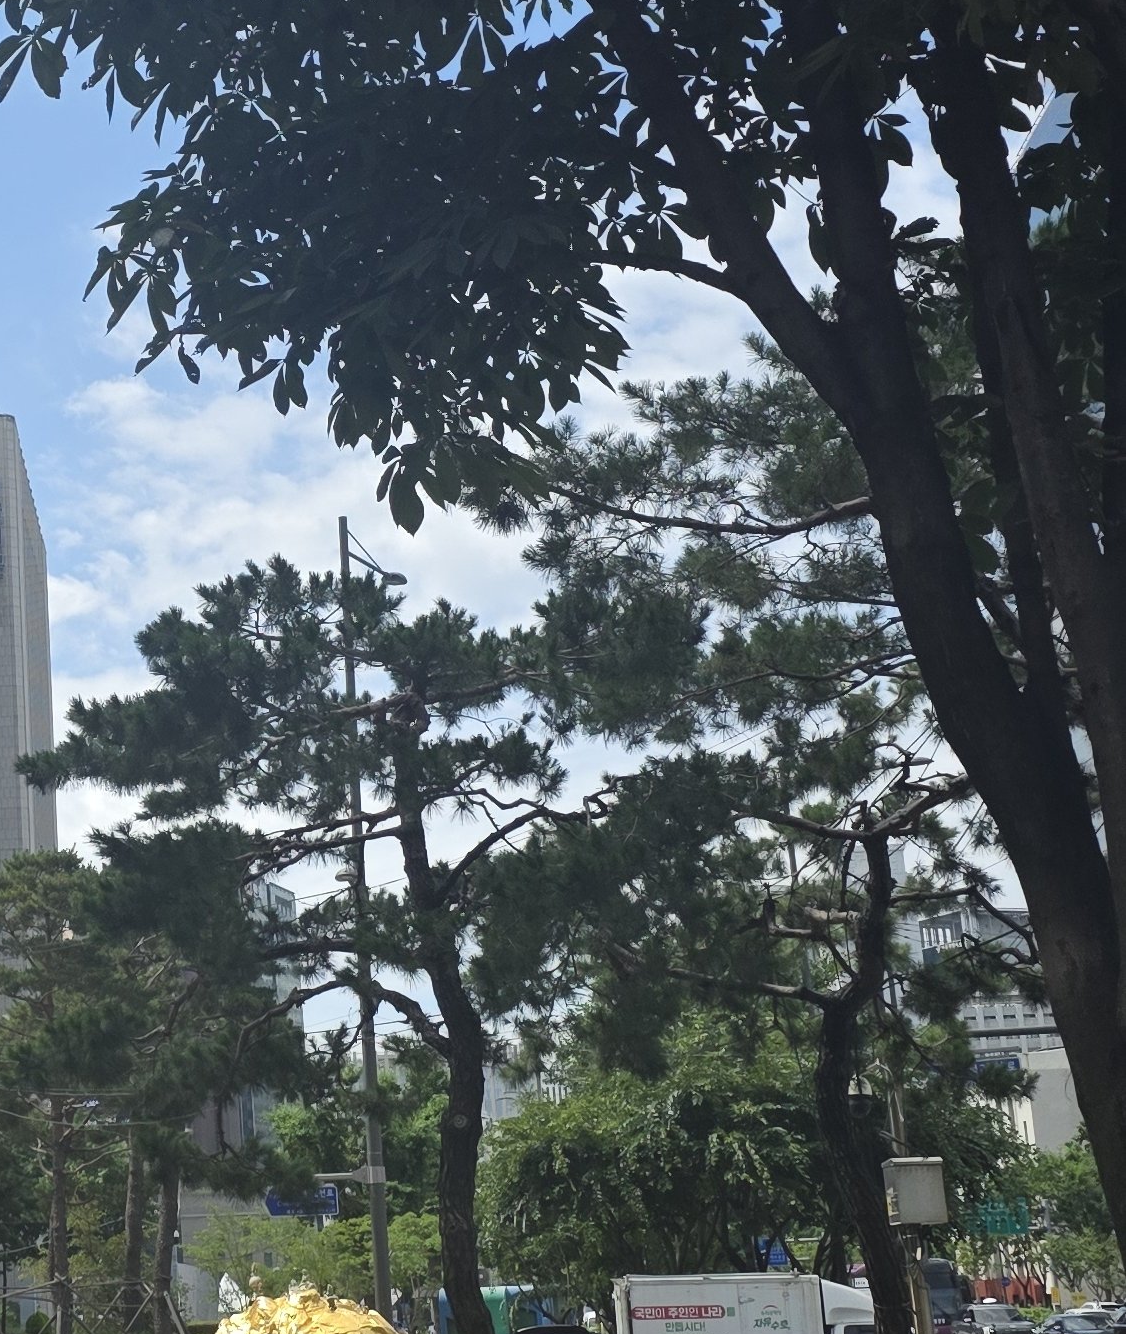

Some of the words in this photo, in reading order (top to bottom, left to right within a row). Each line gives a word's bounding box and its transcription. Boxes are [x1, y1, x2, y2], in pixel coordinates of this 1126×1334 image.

[635, 1307, 666, 1319] 국민이
[668, 1307, 699, 1319] 주인인
[702, 1306, 723, 1318] 나라
